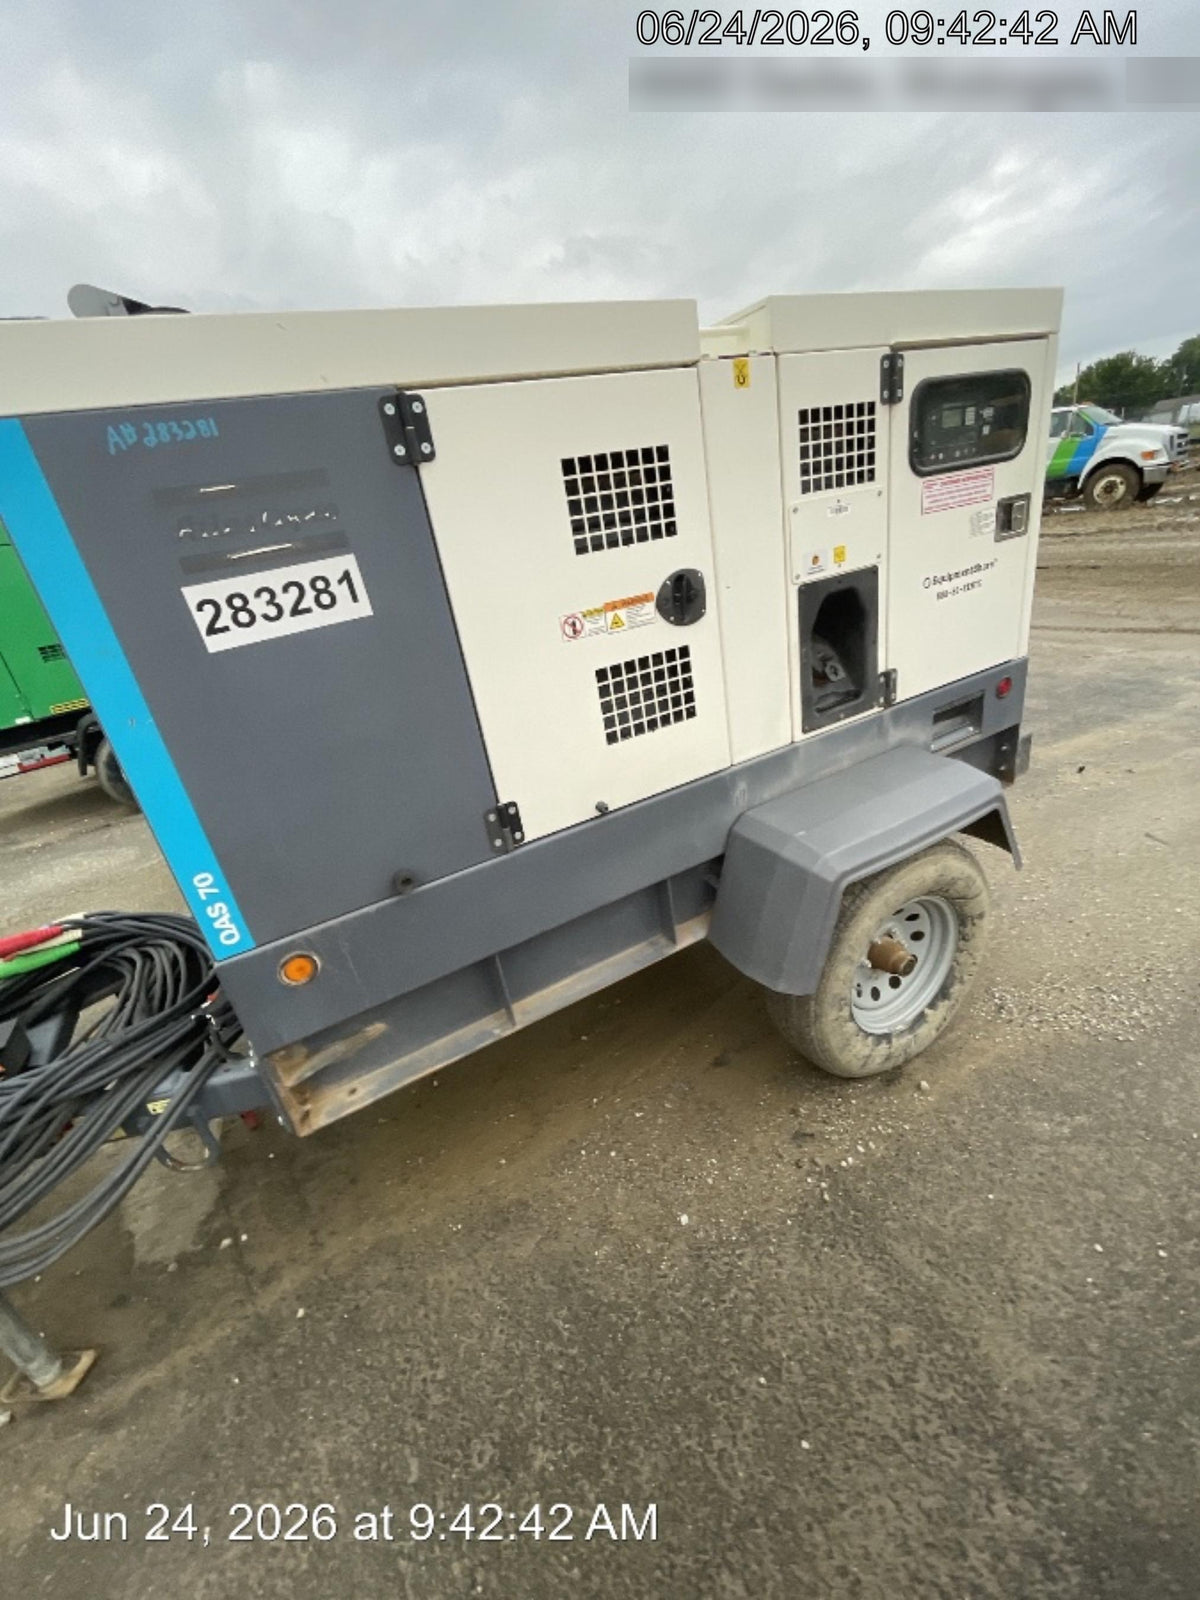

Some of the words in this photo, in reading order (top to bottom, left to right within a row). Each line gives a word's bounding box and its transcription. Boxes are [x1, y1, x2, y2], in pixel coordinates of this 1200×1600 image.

[143, 417, 220, 448] 283281
[196, 569, 359, 637] 283281
[193, 872, 220, 900] 70
[206, 902, 241, 945] QAS
